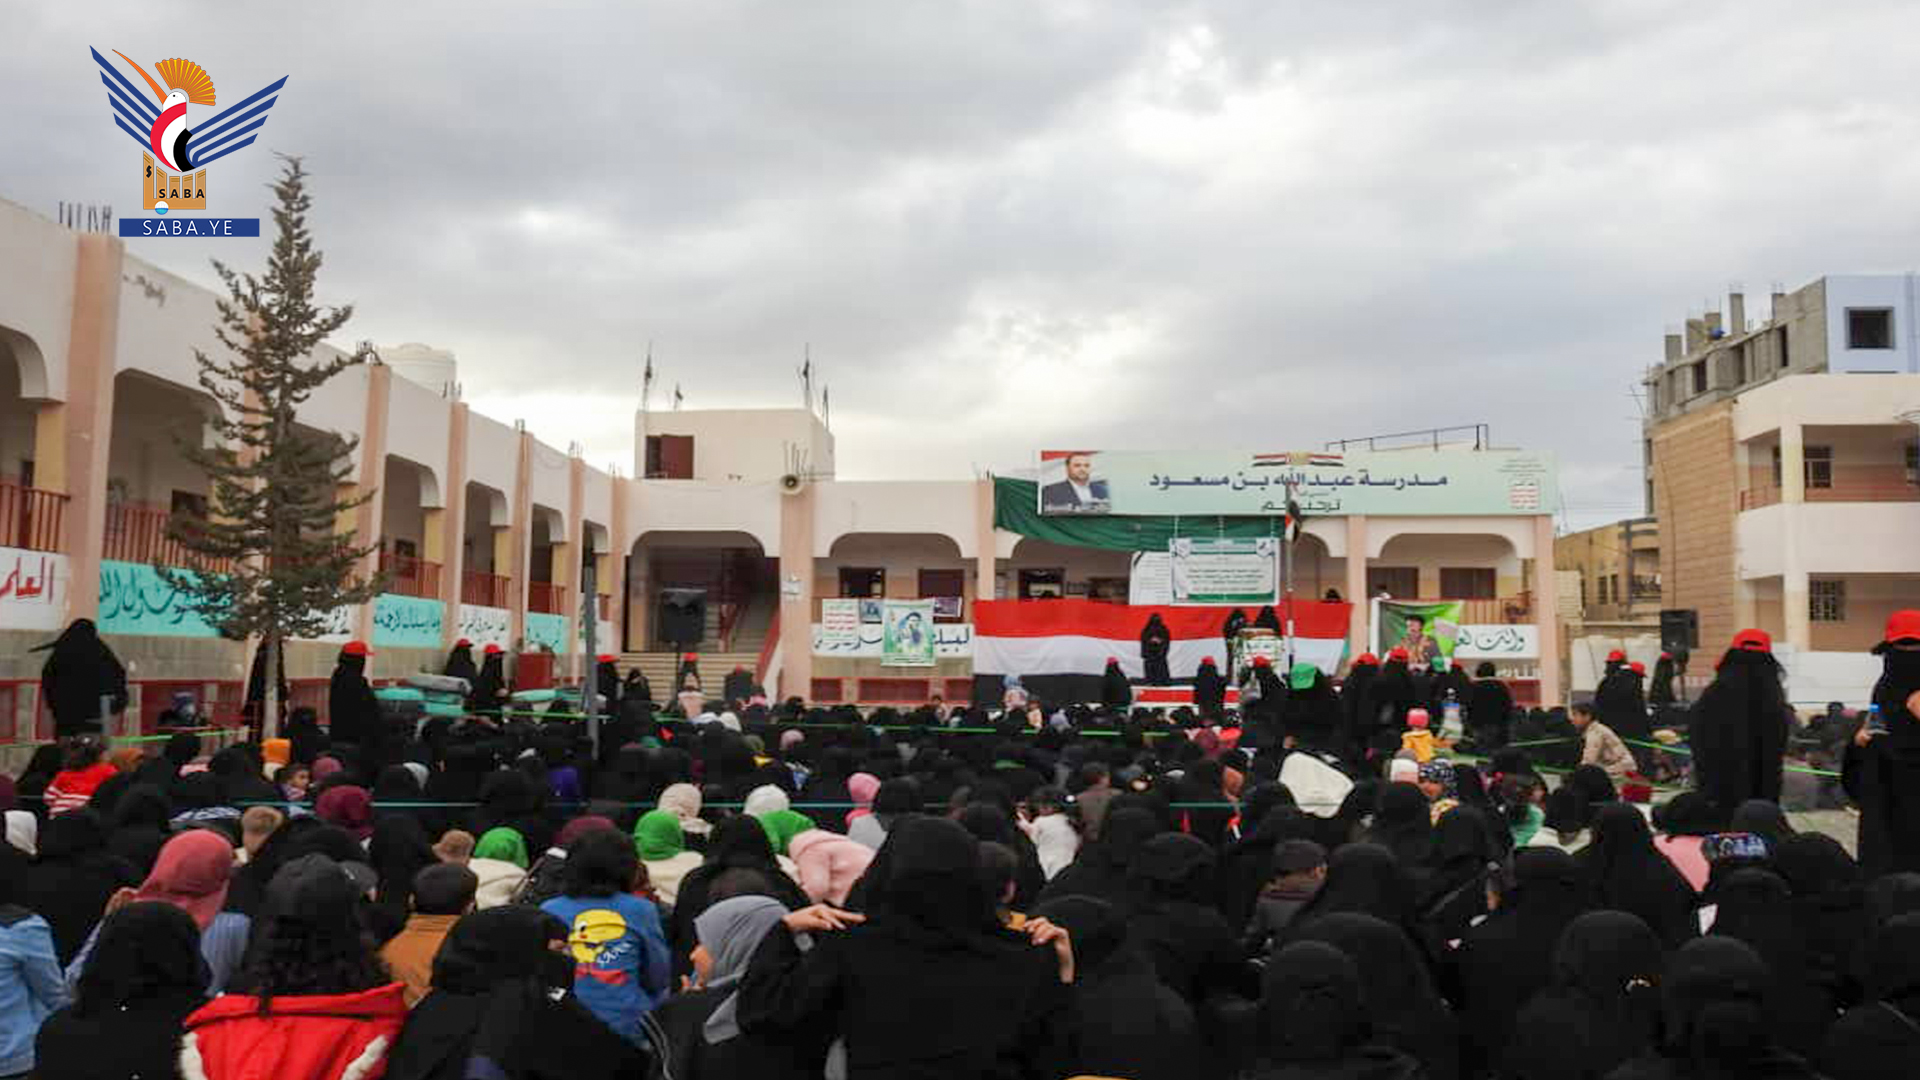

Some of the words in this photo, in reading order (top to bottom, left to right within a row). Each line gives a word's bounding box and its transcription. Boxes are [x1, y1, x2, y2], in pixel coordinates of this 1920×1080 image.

[1149, 473, 1229, 490] مسعود
[1231, 471, 1269, 490] بن
[1358, 469, 1448, 490] مدرسة
